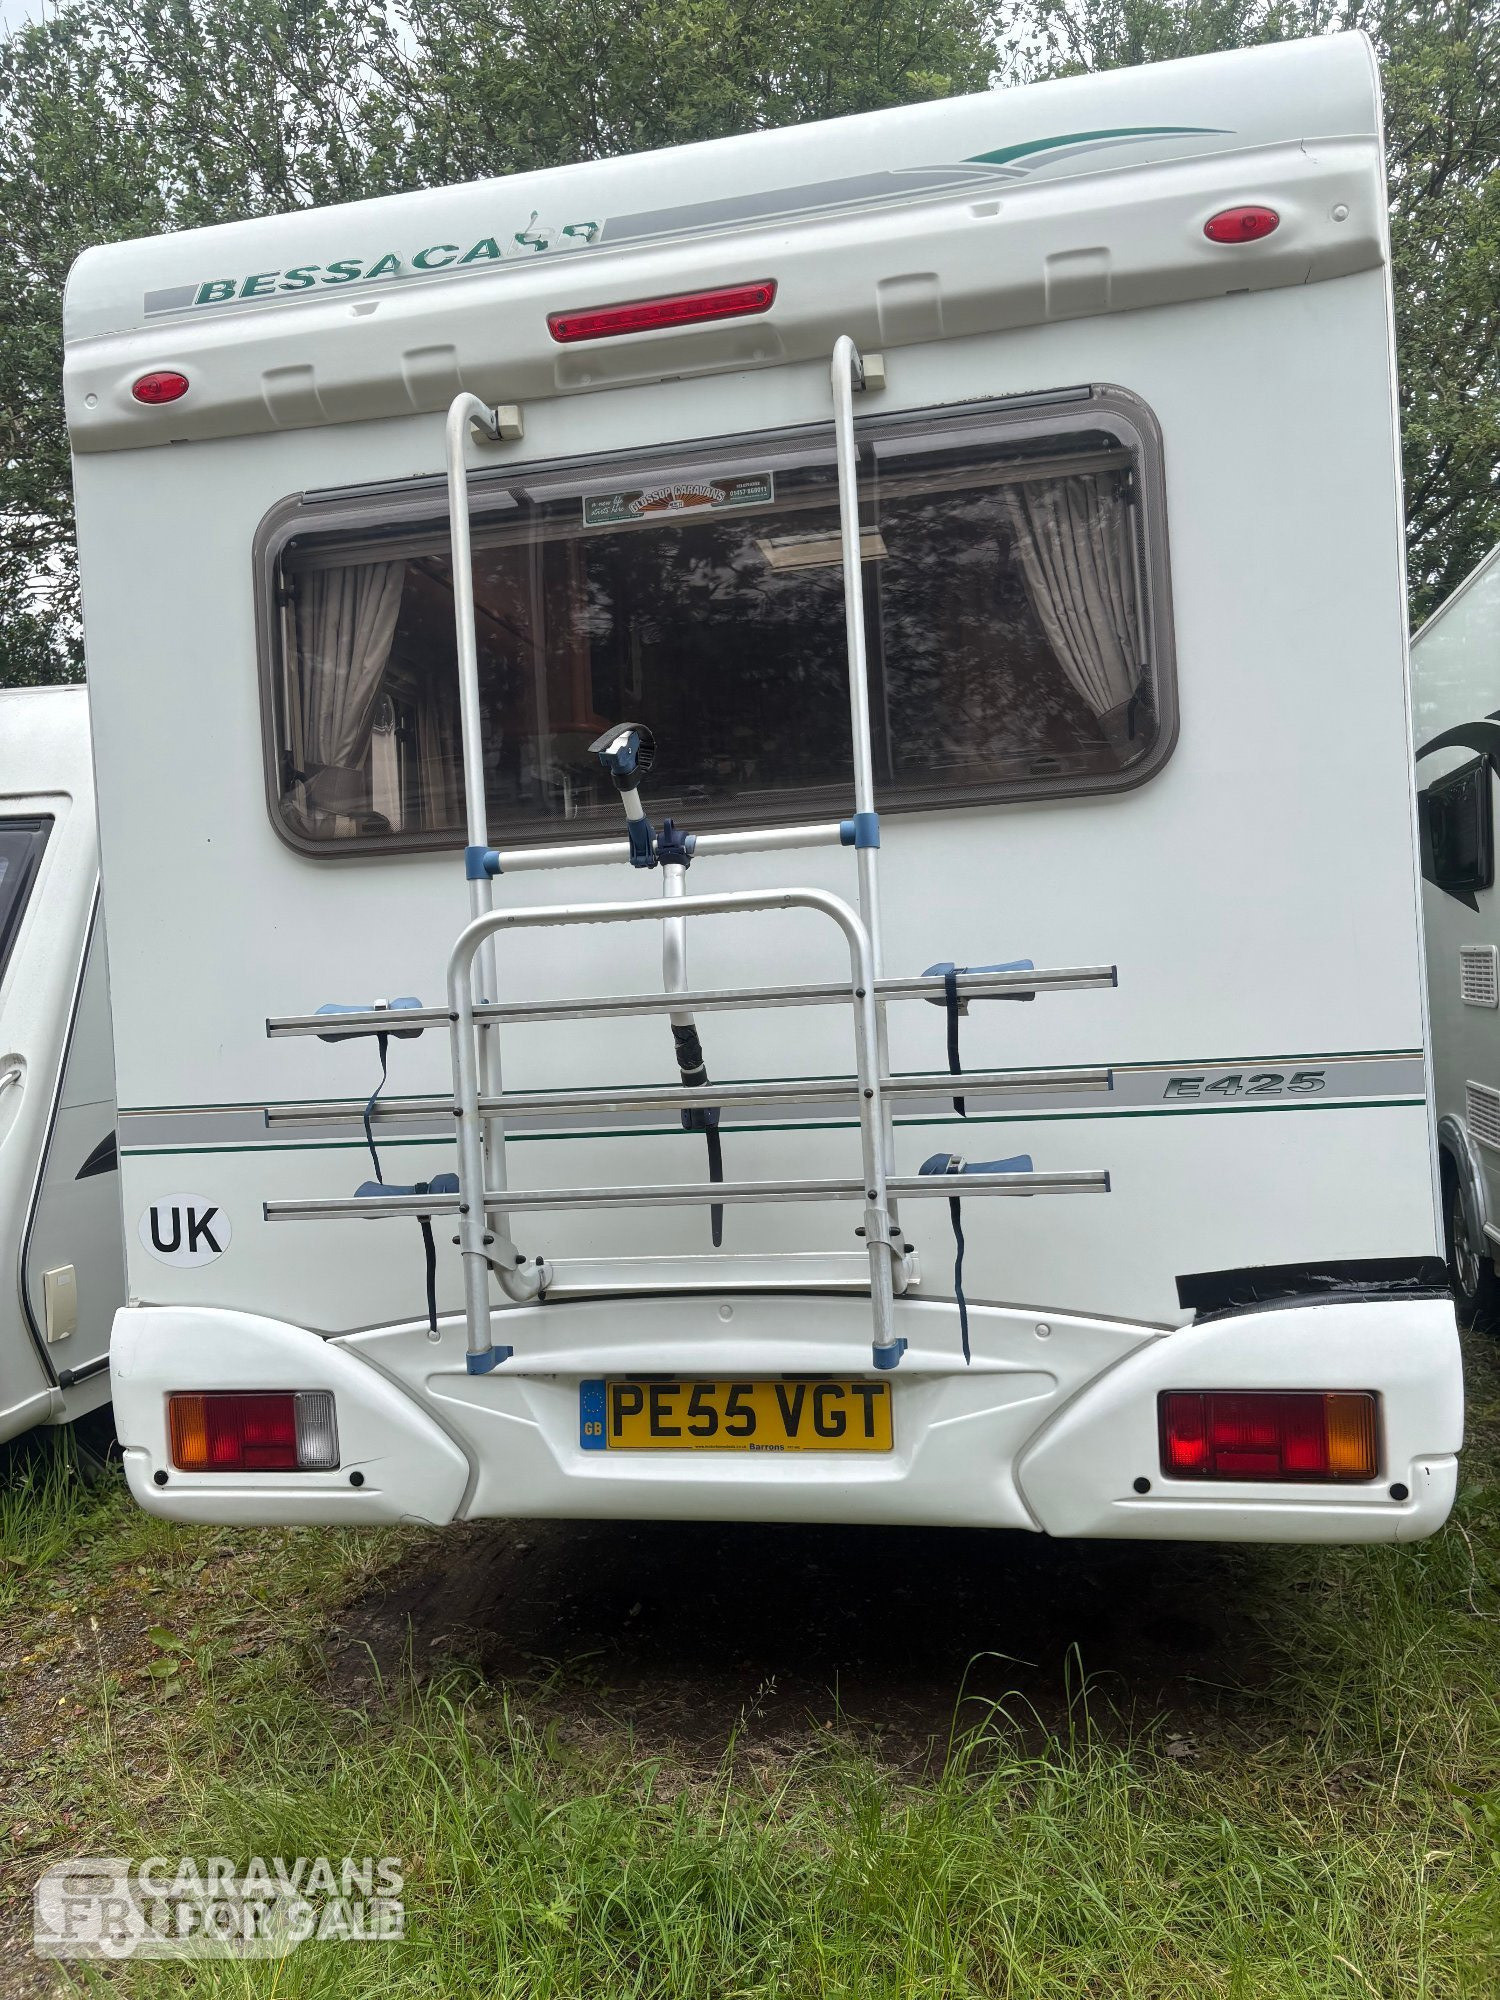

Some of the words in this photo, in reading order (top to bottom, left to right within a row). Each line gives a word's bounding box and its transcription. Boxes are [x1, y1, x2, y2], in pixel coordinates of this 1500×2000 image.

[629, 486, 671, 514] GLOSSOP
[673, 484, 726, 503] CARAVANS
[1163, 1071, 1326, 1098] E425
[149, 1206, 223, 1253] UK
[612, 1384, 756, 1437] PE55
[774, 1384, 884, 1437] VGT
[584, 1421, 602, 1435] GB
[749, 1443, 785, 1451] Barrons
